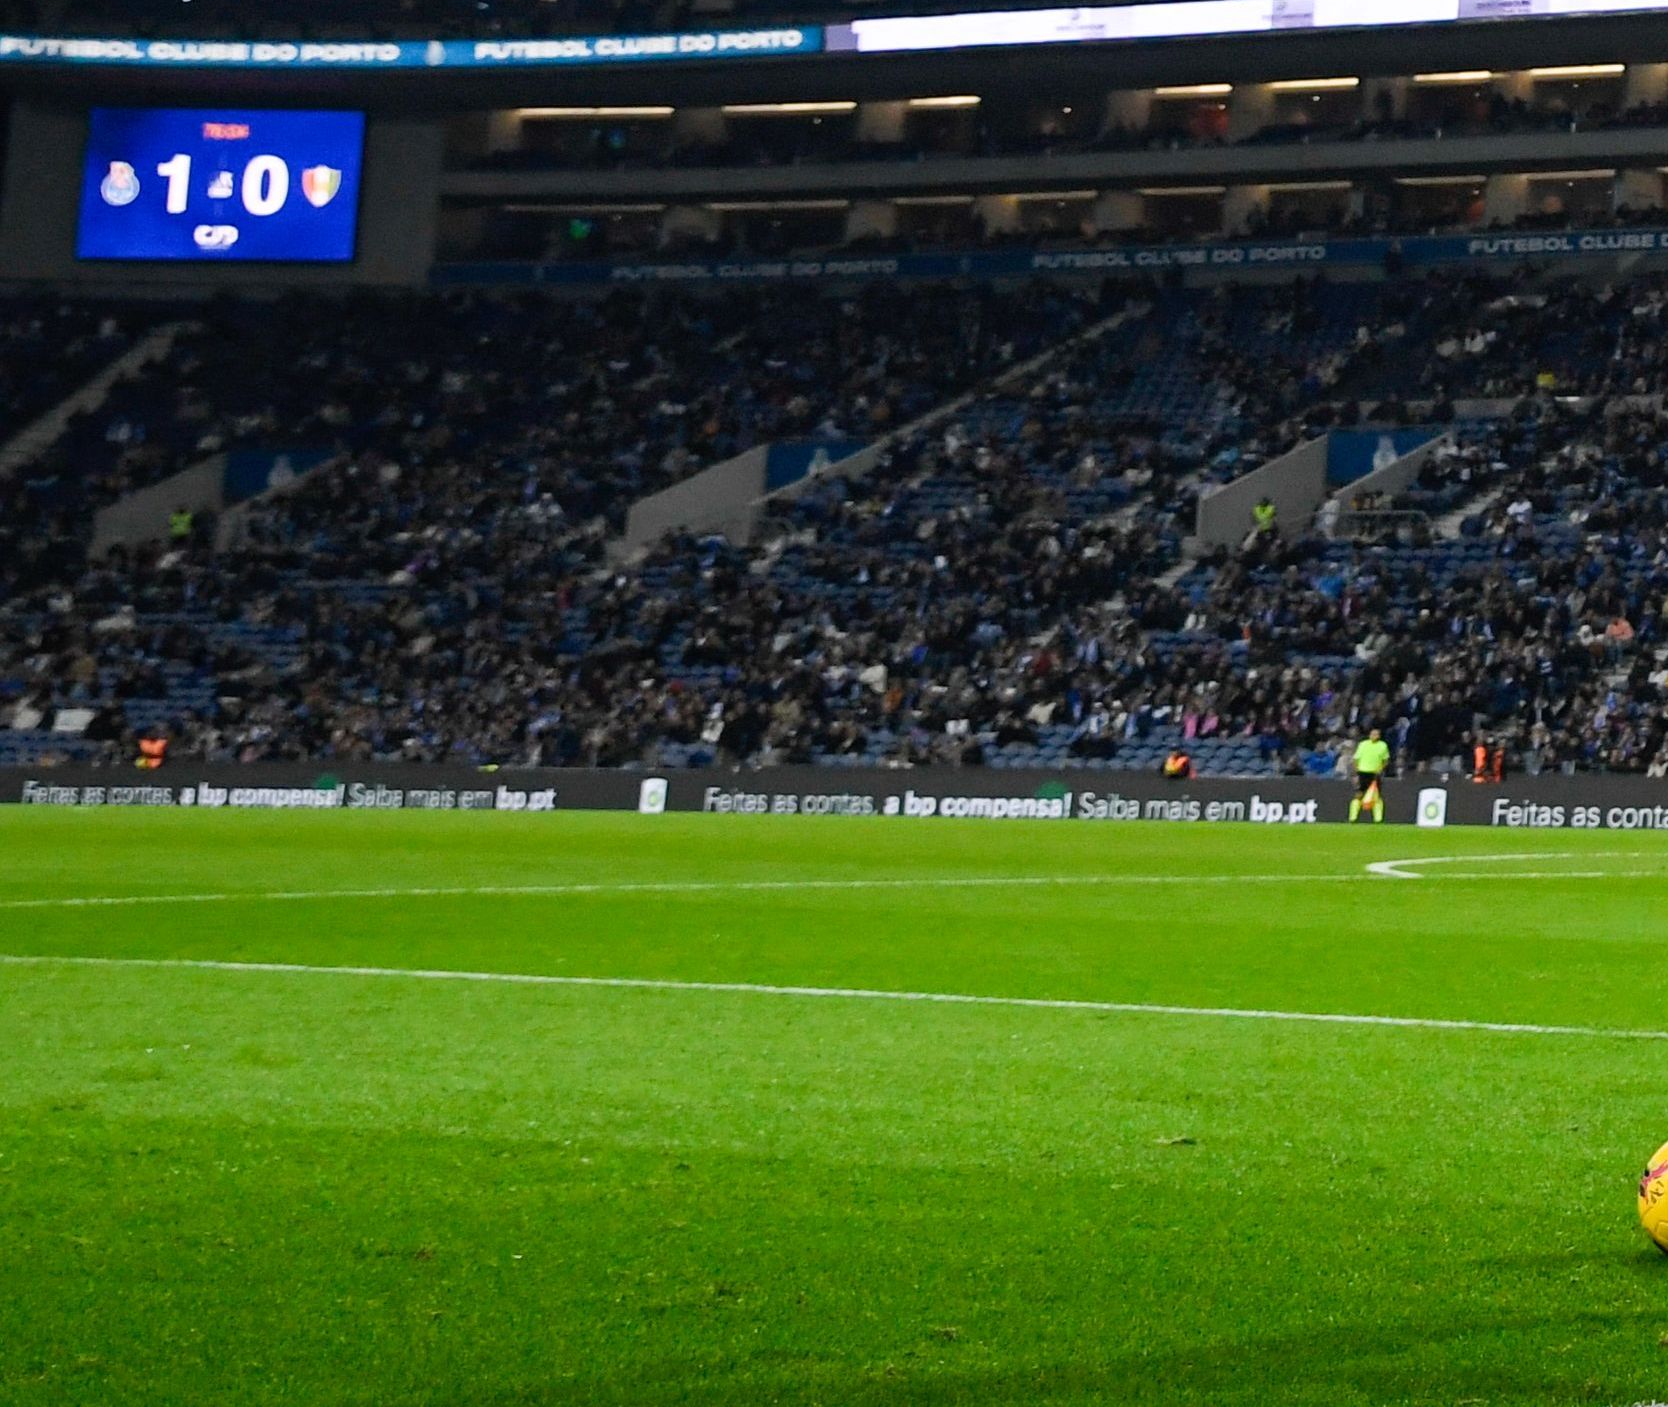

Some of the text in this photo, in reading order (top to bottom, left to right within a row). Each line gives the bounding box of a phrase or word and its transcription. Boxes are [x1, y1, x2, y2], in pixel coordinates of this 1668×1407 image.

[157, 153, 290, 216] 1 0
[1470, 238, 1574, 254] FUTEBOL
[1579, 234, 1655, 250] CLUBE
[704, 787, 768, 813] Feitas
[771, 794, 798, 814] as
[883, 795, 900, 815] a
[904, 790, 936, 817] bp
[939, 792, 1072, 818] compensa!
[1077, 792, 1140, 819] Saiba
[1144, 795, 1200, 821] mais
[1204, 800, 1245, 821] em
[1250, 795, 1318, 823] bp.pt
[1492, 798, 1565, 827] Feitas
[1570, 805, 1600, 828] as
